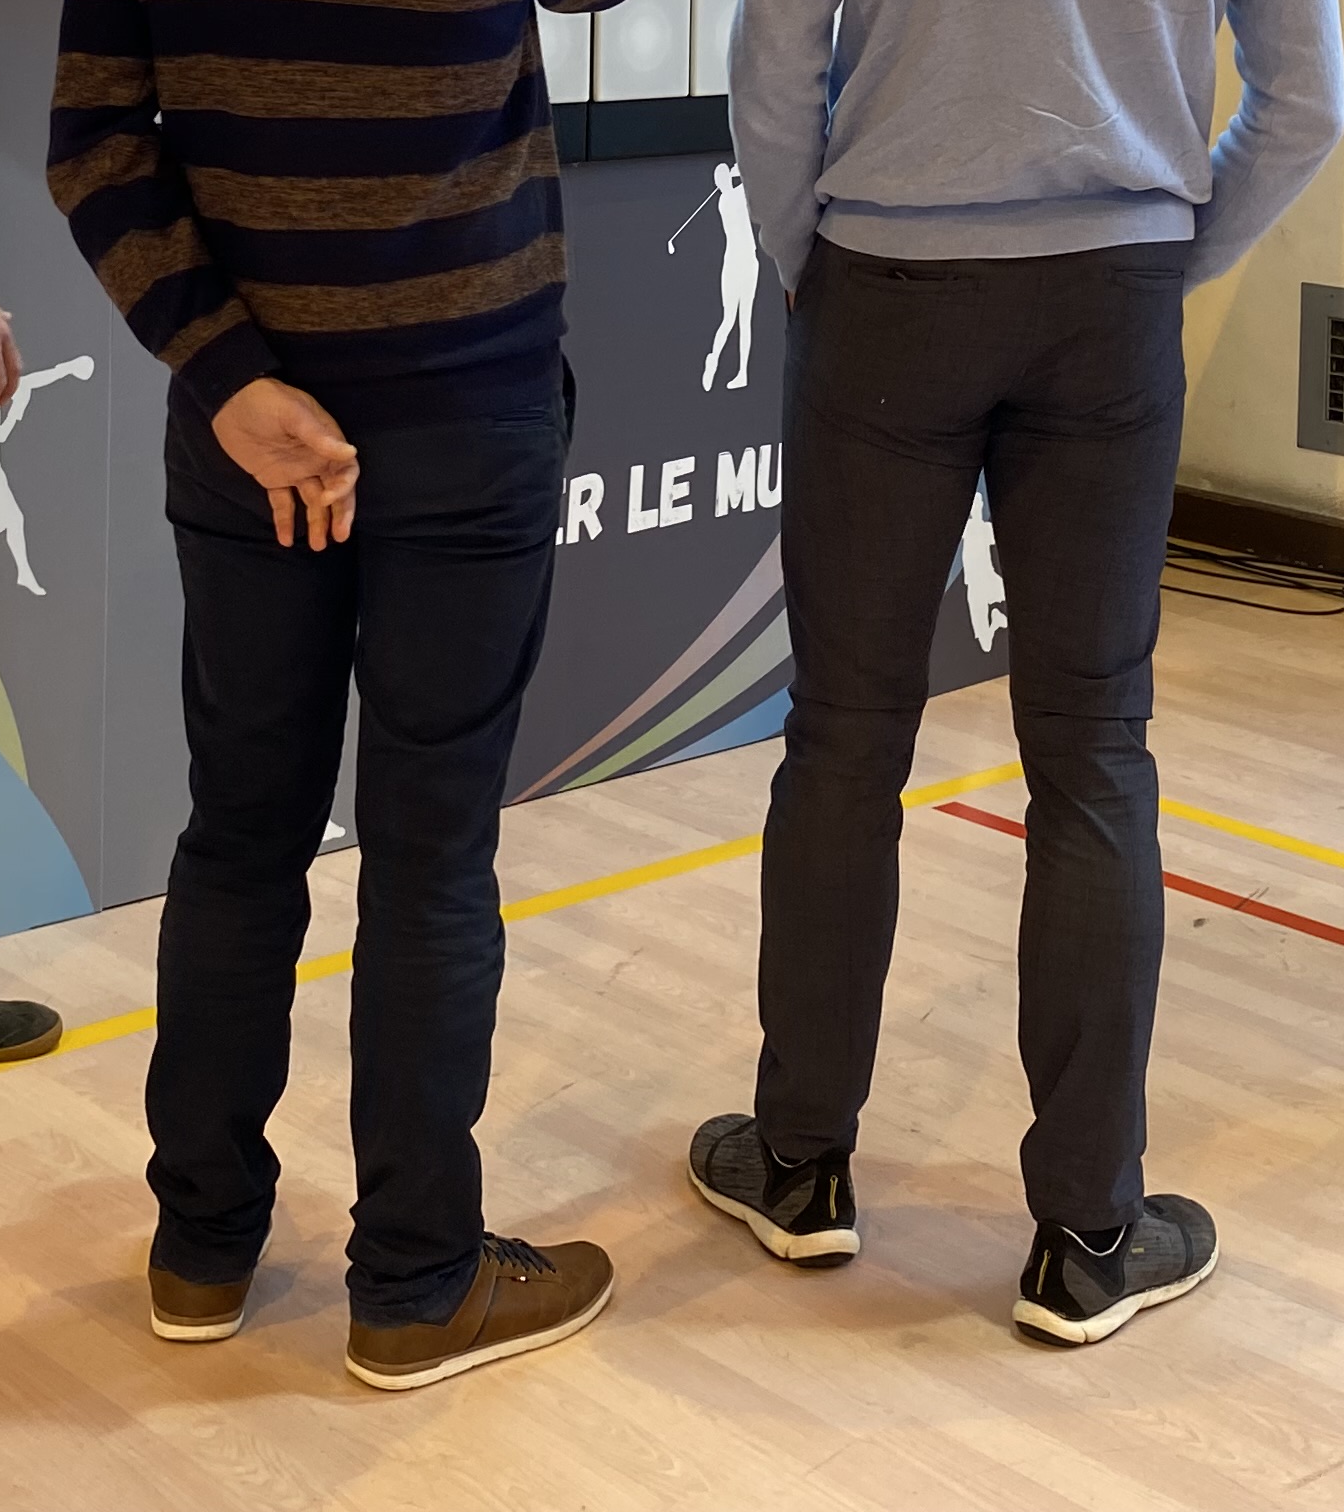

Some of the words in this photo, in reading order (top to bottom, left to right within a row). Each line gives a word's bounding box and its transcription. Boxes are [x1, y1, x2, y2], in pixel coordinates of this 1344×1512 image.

[555, 472, 605, 546] R
[627, 455, 696, 534] LE
[714, 442, 783, 518] MU
